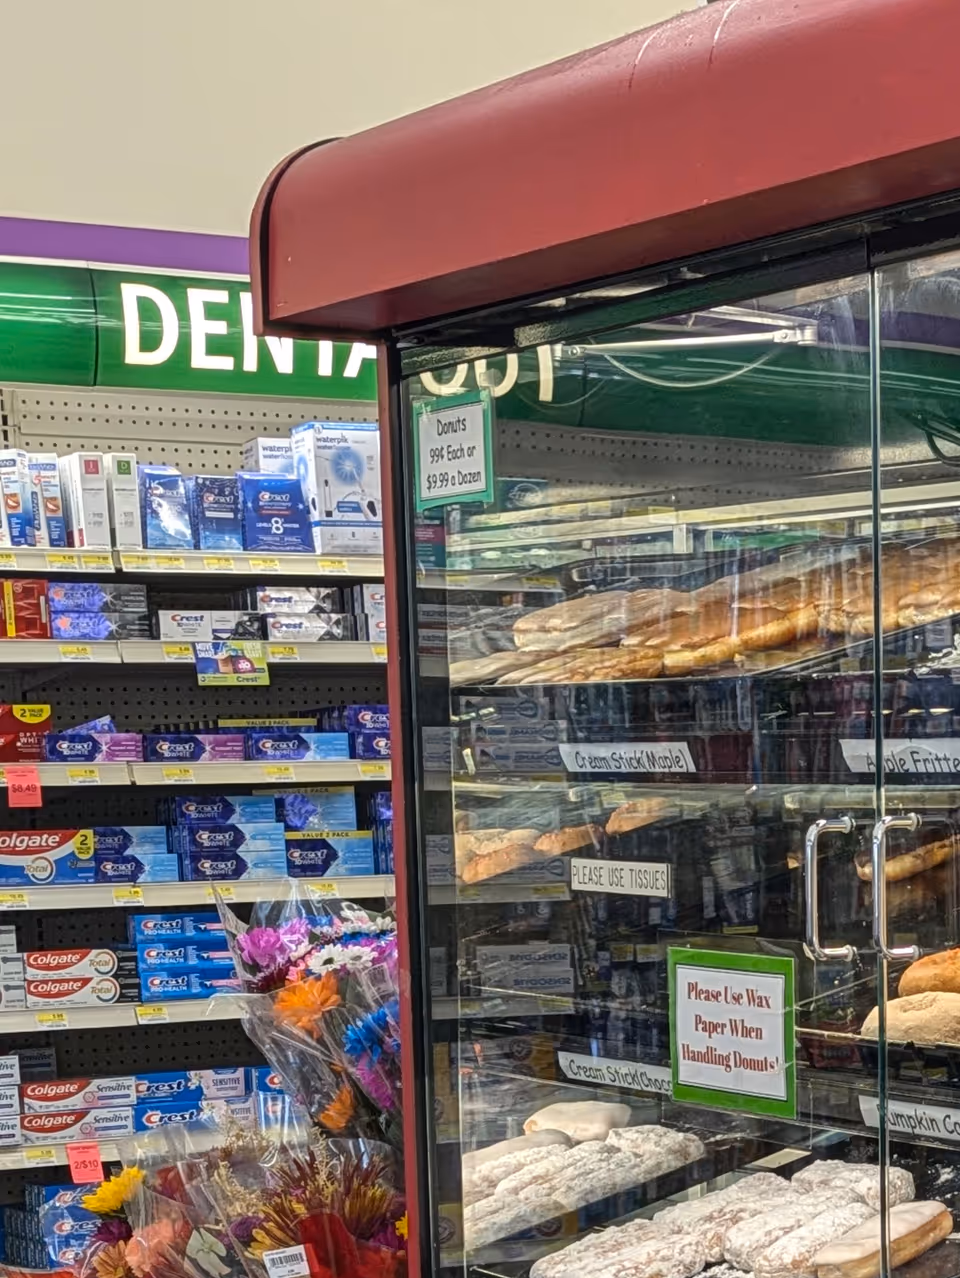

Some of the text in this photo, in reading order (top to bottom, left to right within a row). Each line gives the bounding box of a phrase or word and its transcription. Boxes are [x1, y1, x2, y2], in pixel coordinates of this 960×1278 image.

[437, 417, 467, 436] Donuts
[430, 444, 476, 464] 99¢ Each or
[427, 472, 449, 492] $9.99
[457, 470, 481, 487] Dozen
[261, 594, 293, 603] Crest
[171, 614, 205, 622] Crest
[271, 621, 304, 630] Crest
[20, 709, 27, 717] 2
[56, 741, 92, 750] Crest
[156, 741, 194, 752] Crest
[259, 739, 298, 751] Crest
[575, 751, 611, 770] Cream
[11, 783, 37, 793] $8.49
[183, 802, 223, 813] Crest
[0, 833, 59, 850] olgate
[80, 835, 88, 846] 2
[196, 831, 234, 842] Crest
[288, 849, 327, 861] Crest
[25, 864, 49, 873] Total
[101, 862, 136, 872] Crest
[198, 859, 237, 871] Crest
[572, 865, 666, 890] PLEASE USE TISSUES
[142, 920, 181, 930] Crest
[144, 948, 184, 958] Crest
[30, 953, 80, 966] Colgate
[89, 959, 111, 967] Total
[149, 976, 188, 986] Crest
[30, 981, 82, 994] Colgate
[91, 986, 113, 994] Total
[688, 981, 771, 1009] Please Use Wax
[694, 1014, 763, 1040] Paper When
[681, 1043, 780, 1073] Handling Donuts!
[569, 1060, 605, 1081] Cream
[134, 1079, 184, 1094] Crest
[212, 1077, 240, 1086] SENSITIVE
[27, 1084, 79, 1096] Colgate
[97, 1083, 132, 1093] Sensitive
[24, 1115, 76, 1128] Colgate
[94, 1114, 130, 1123] Sensitive
[142, 1110, 197, 1126] Crest
[877, 1104, 940, 1134] umpkin
[74, 1160, 98, 1170] 2/$10
